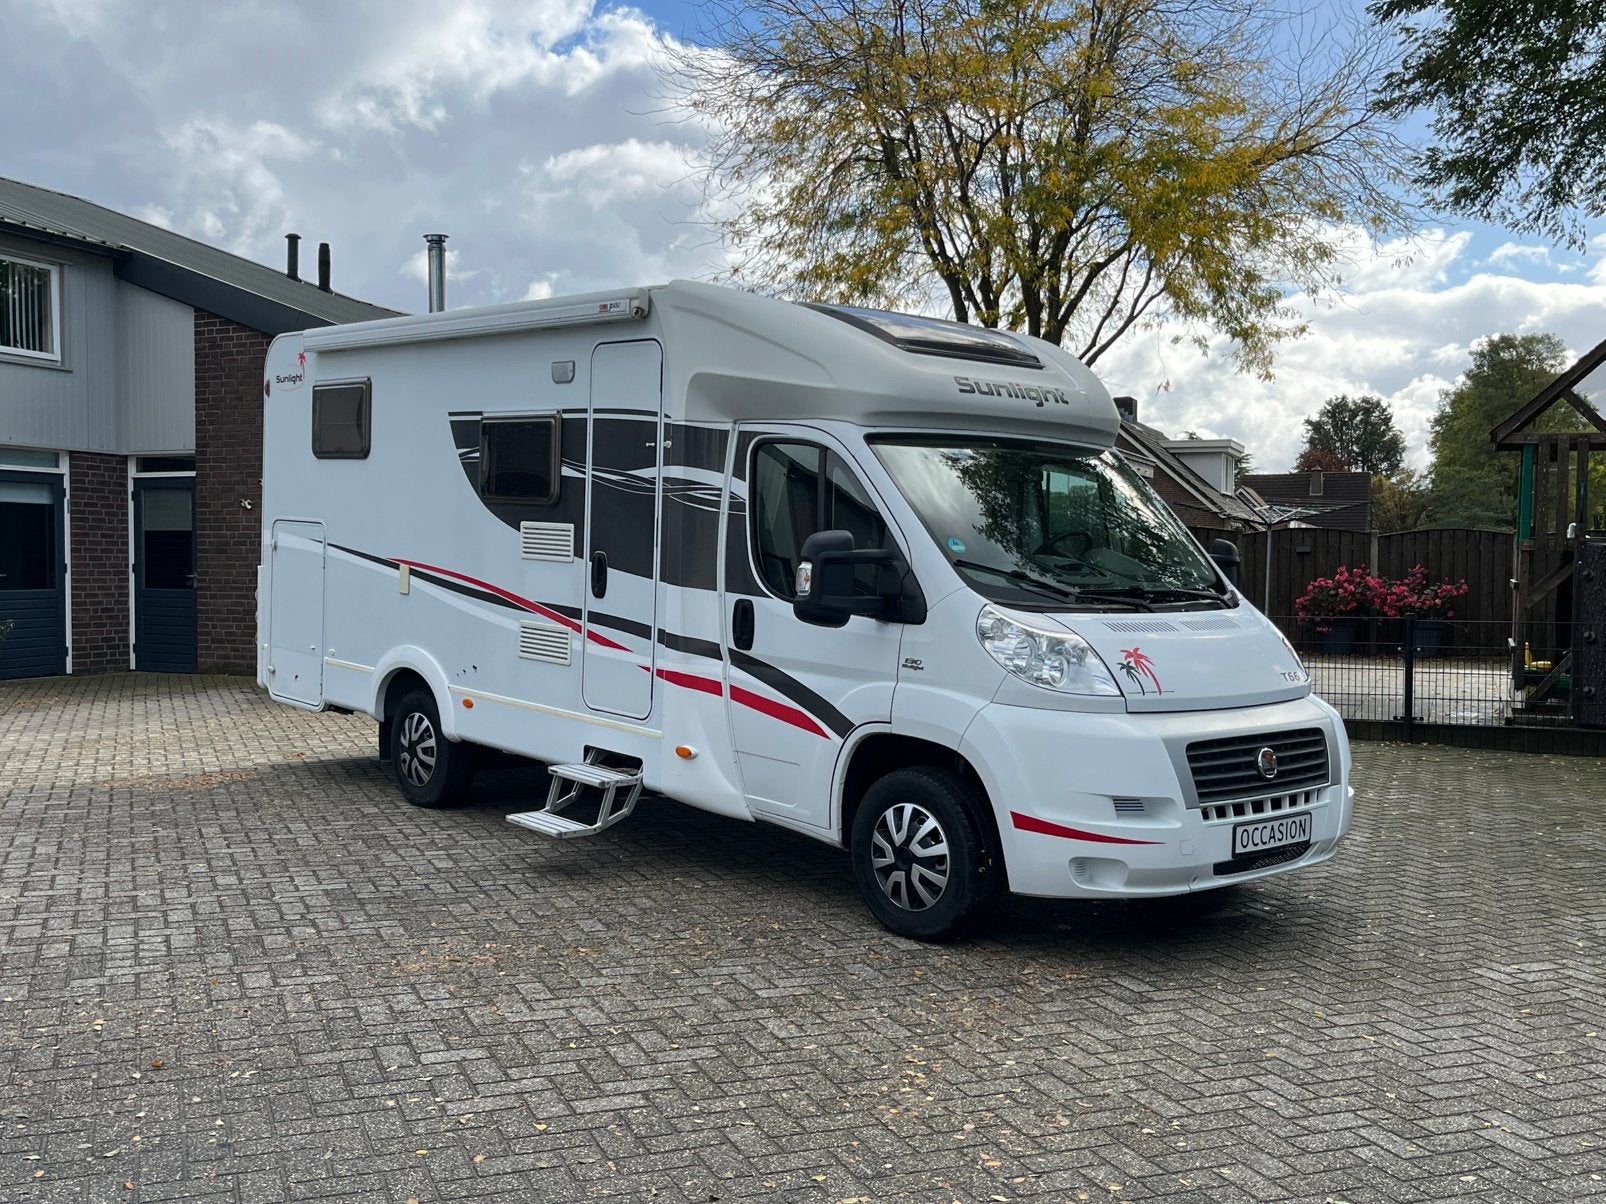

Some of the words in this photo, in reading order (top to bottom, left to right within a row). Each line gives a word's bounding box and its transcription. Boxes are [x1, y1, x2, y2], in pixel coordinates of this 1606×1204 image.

[275, 373, 303, 385] Sunlight
[953, 376, 1069, 408] Sunlight
[1280, 671, 1301, 683] T66
[1240, 818, 1307, 849] OCCASION
